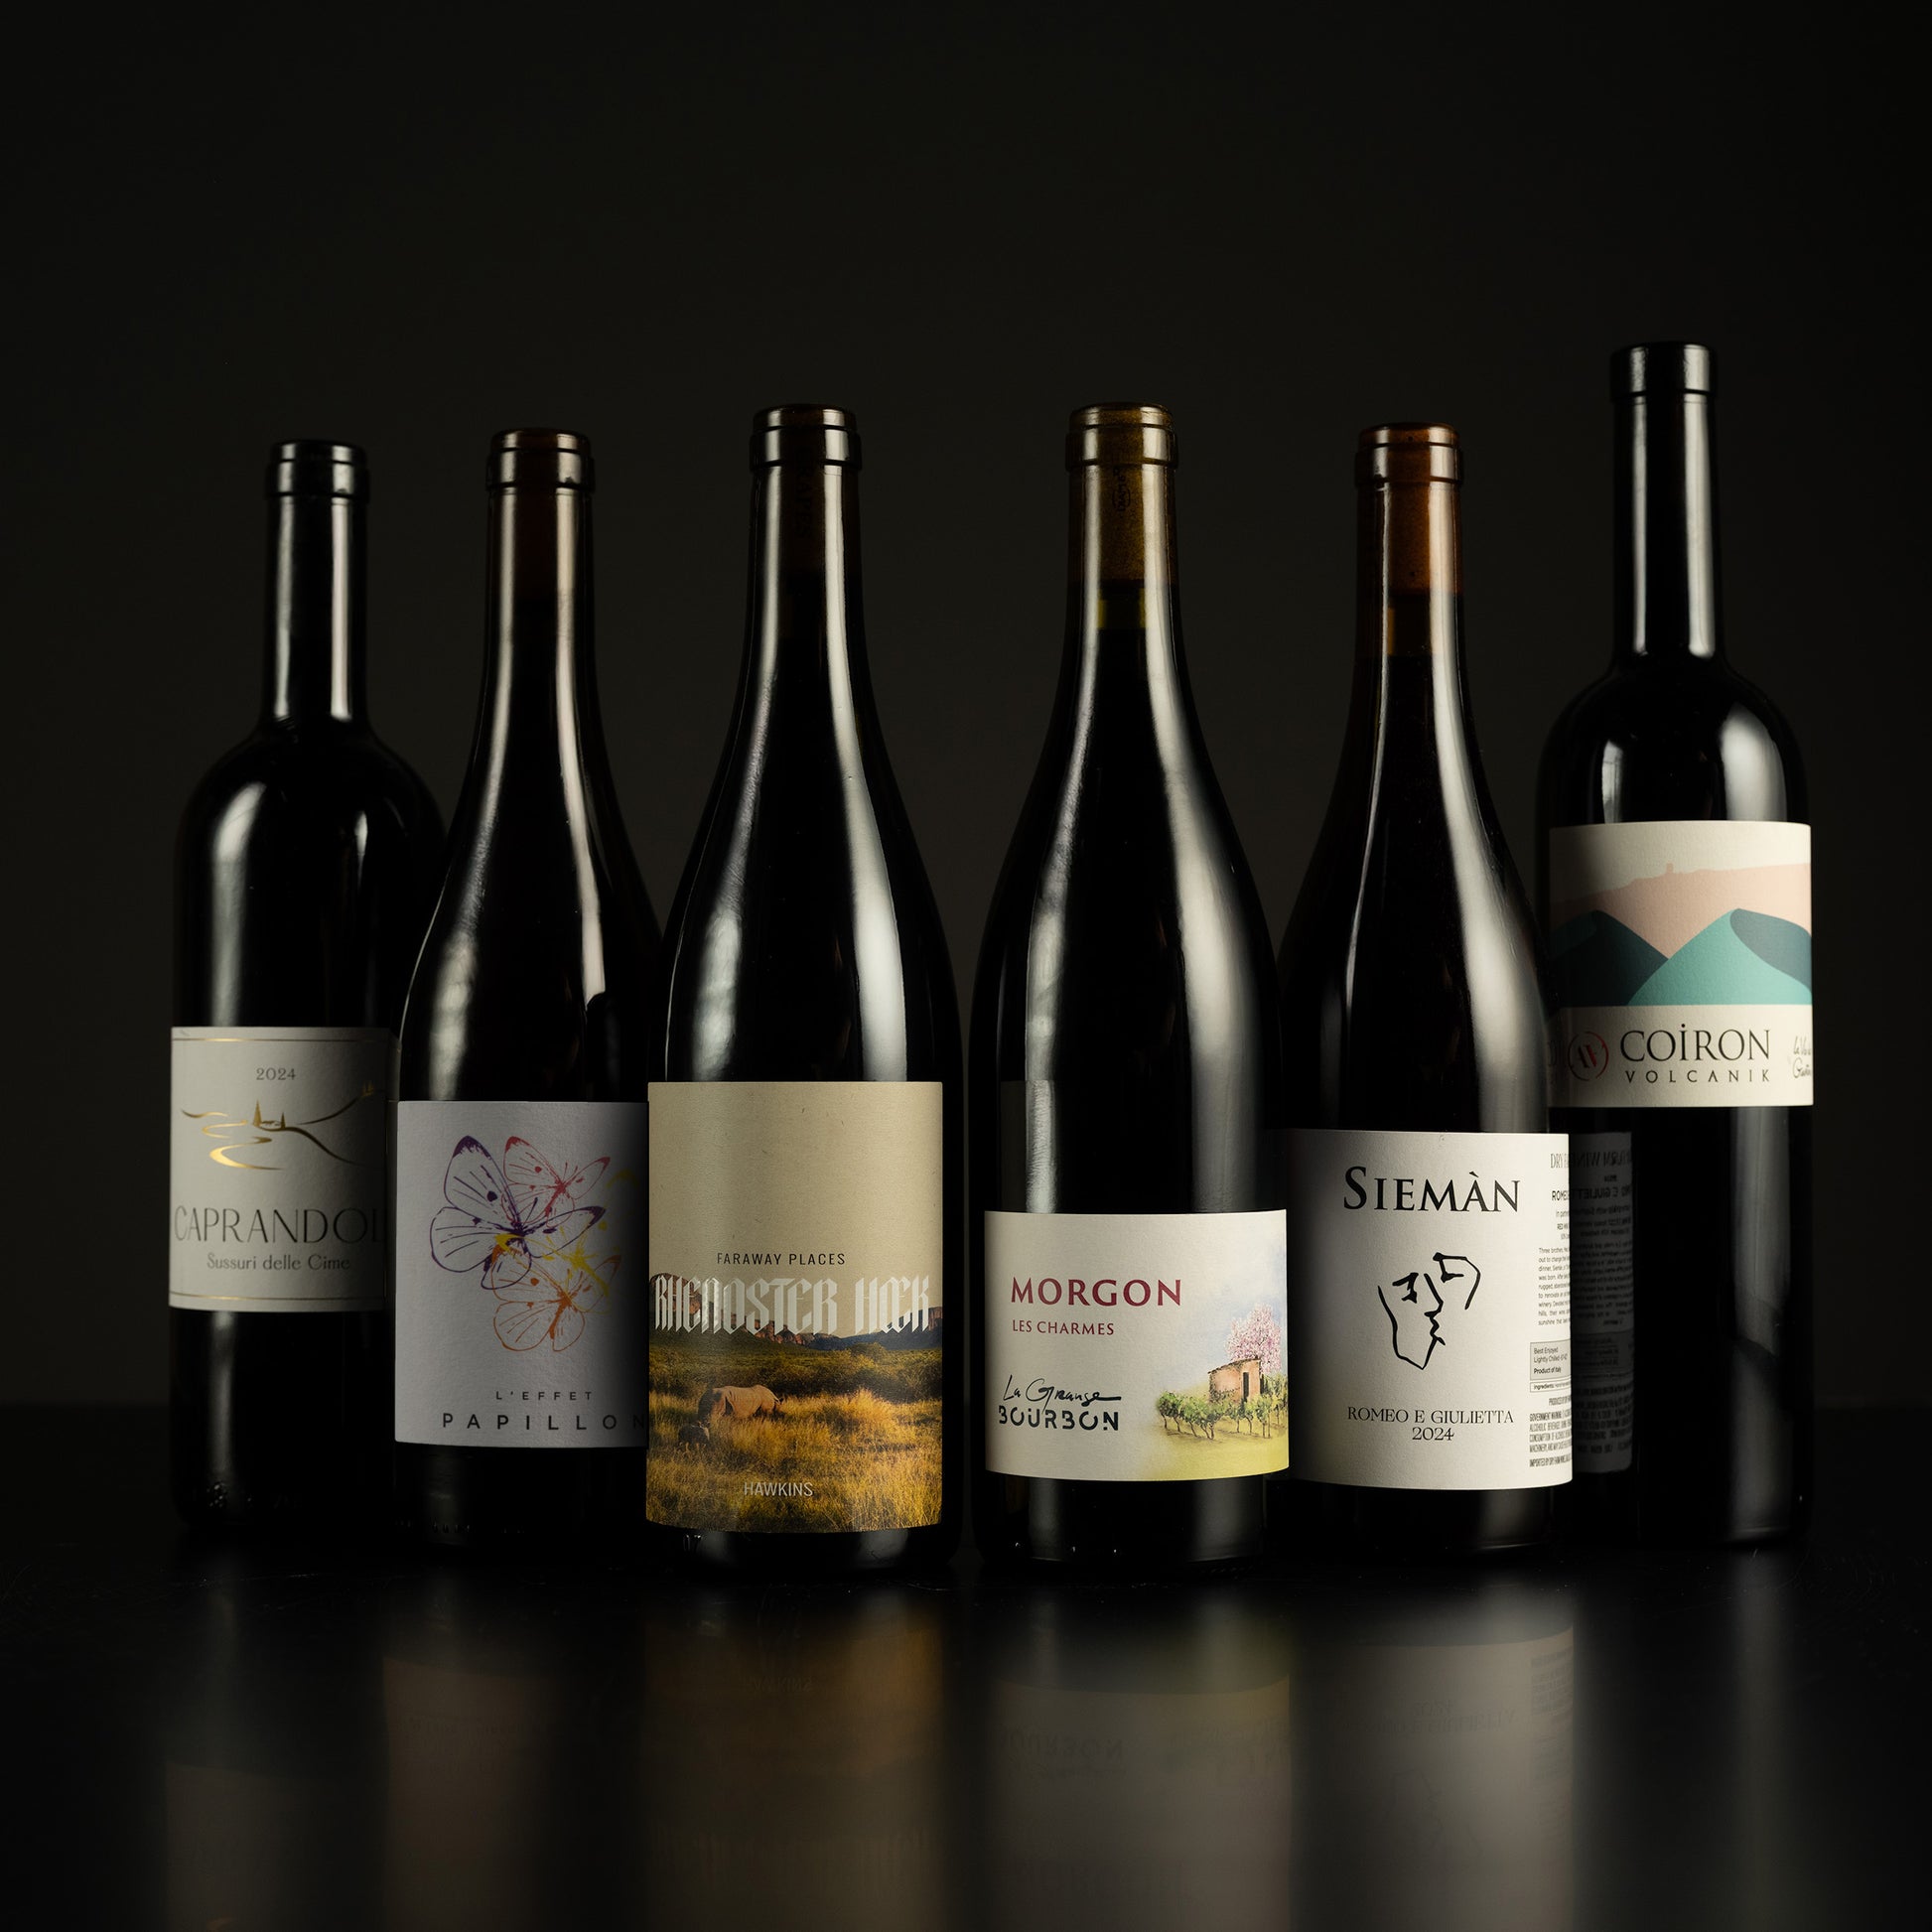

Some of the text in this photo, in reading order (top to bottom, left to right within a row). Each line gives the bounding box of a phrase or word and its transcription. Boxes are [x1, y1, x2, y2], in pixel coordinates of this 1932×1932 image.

[256, 1067, 297, 1081] 2024
[1625, 1069, 1770, 1083] VOLCANIK
[1343, 1166, 1521, 1212] SIEMÀN
[207, 1253, 350, 1271] Sussuri delle Cime
[717, 1253, 846, 1266] FARAWAY PLACES
[1011, 1277, 1181, 1307] MORGON
[1012, 1319, 1114, 1335] LES CHARMES
[495, 1391, 593, 1401] L'EFFET
[1003, 1374, 1021, 1401] La
[442, 1413, 644, 1431] PAPILLON
[999, 1405, 1119, 1431] BOURBON
[1347, 1406, 1514, 1424] ROMEO E GIULIETTA
[1412, 1428, 1454, 1442] 2024
[744, 1481, 813, 1497] HAWKINS
